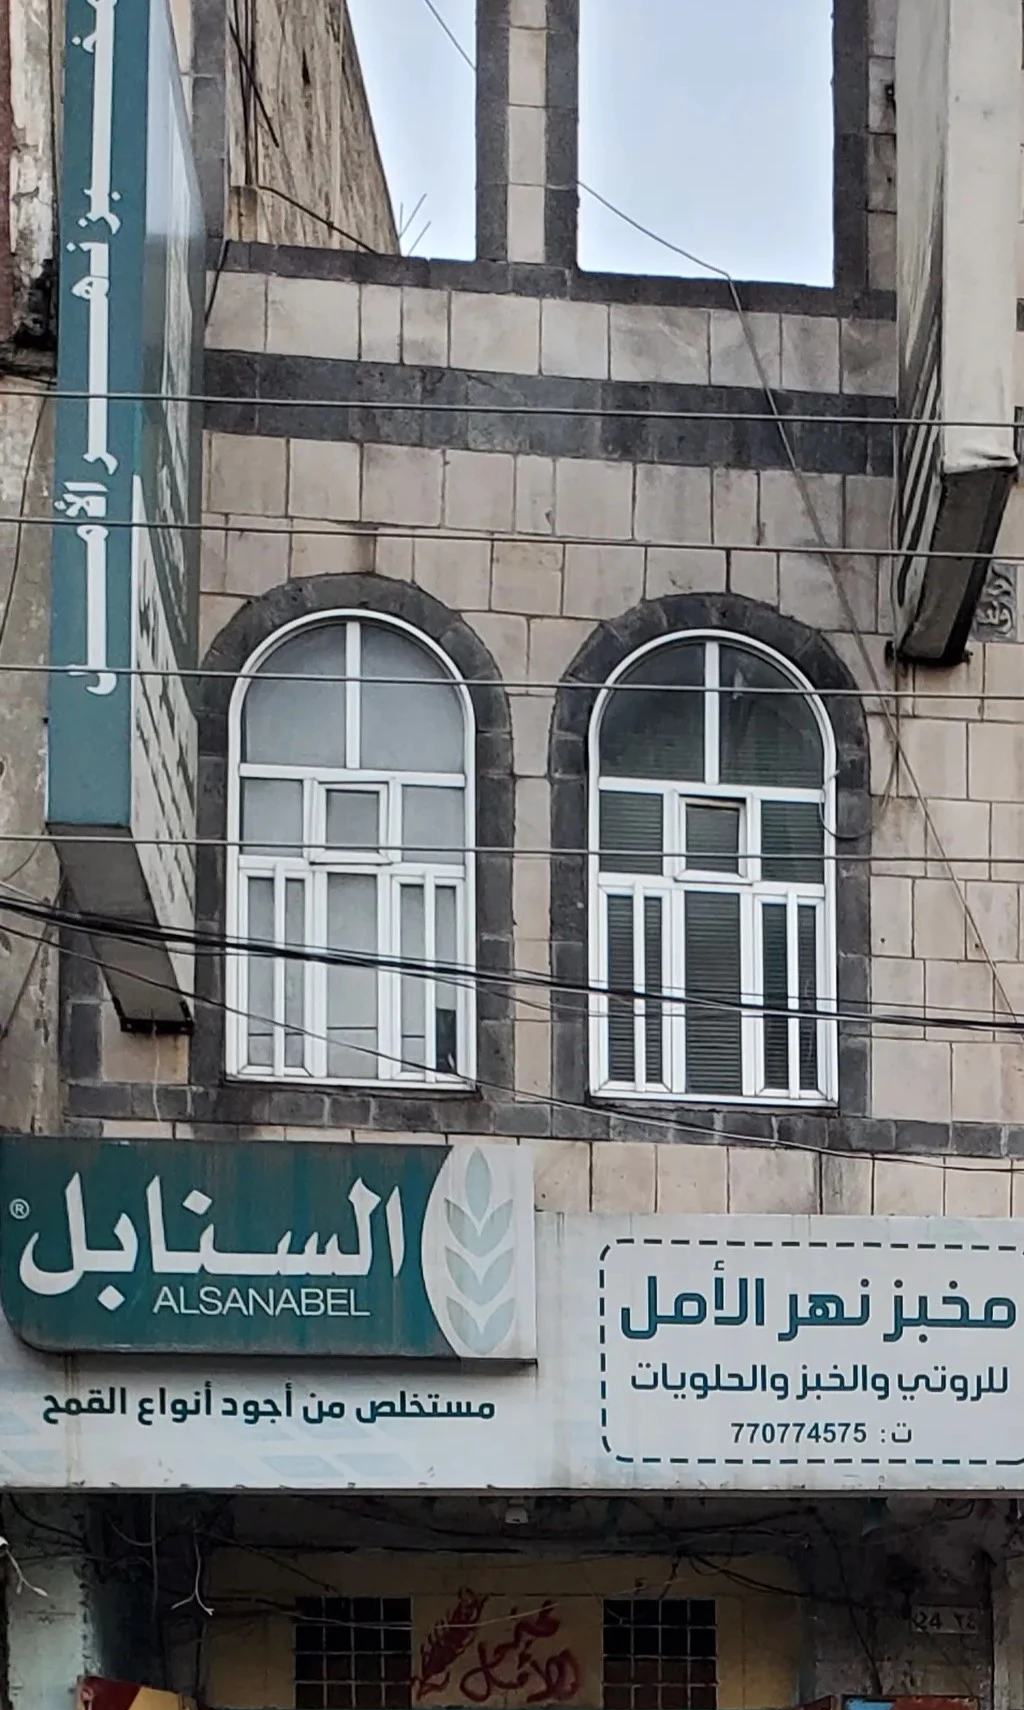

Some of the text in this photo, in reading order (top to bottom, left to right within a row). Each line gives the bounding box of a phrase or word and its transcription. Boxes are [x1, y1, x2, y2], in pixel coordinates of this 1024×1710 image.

[64, 0, 121, 695] خبز نهر الأمل
[19, 1172, 404, 1311] السنابل
[153, 1285, 371, 1317] ALSANABEL
[620, 1260, 1016, 1343] مخبز نهر الأمل
[631, 1362, 1009, 1401] للروتي والخبز والحلويات
[42, 1382, 496, 1425] مستخلص من أجود أنواع القمح
[730, 1422, 868, 1444] 770774575
